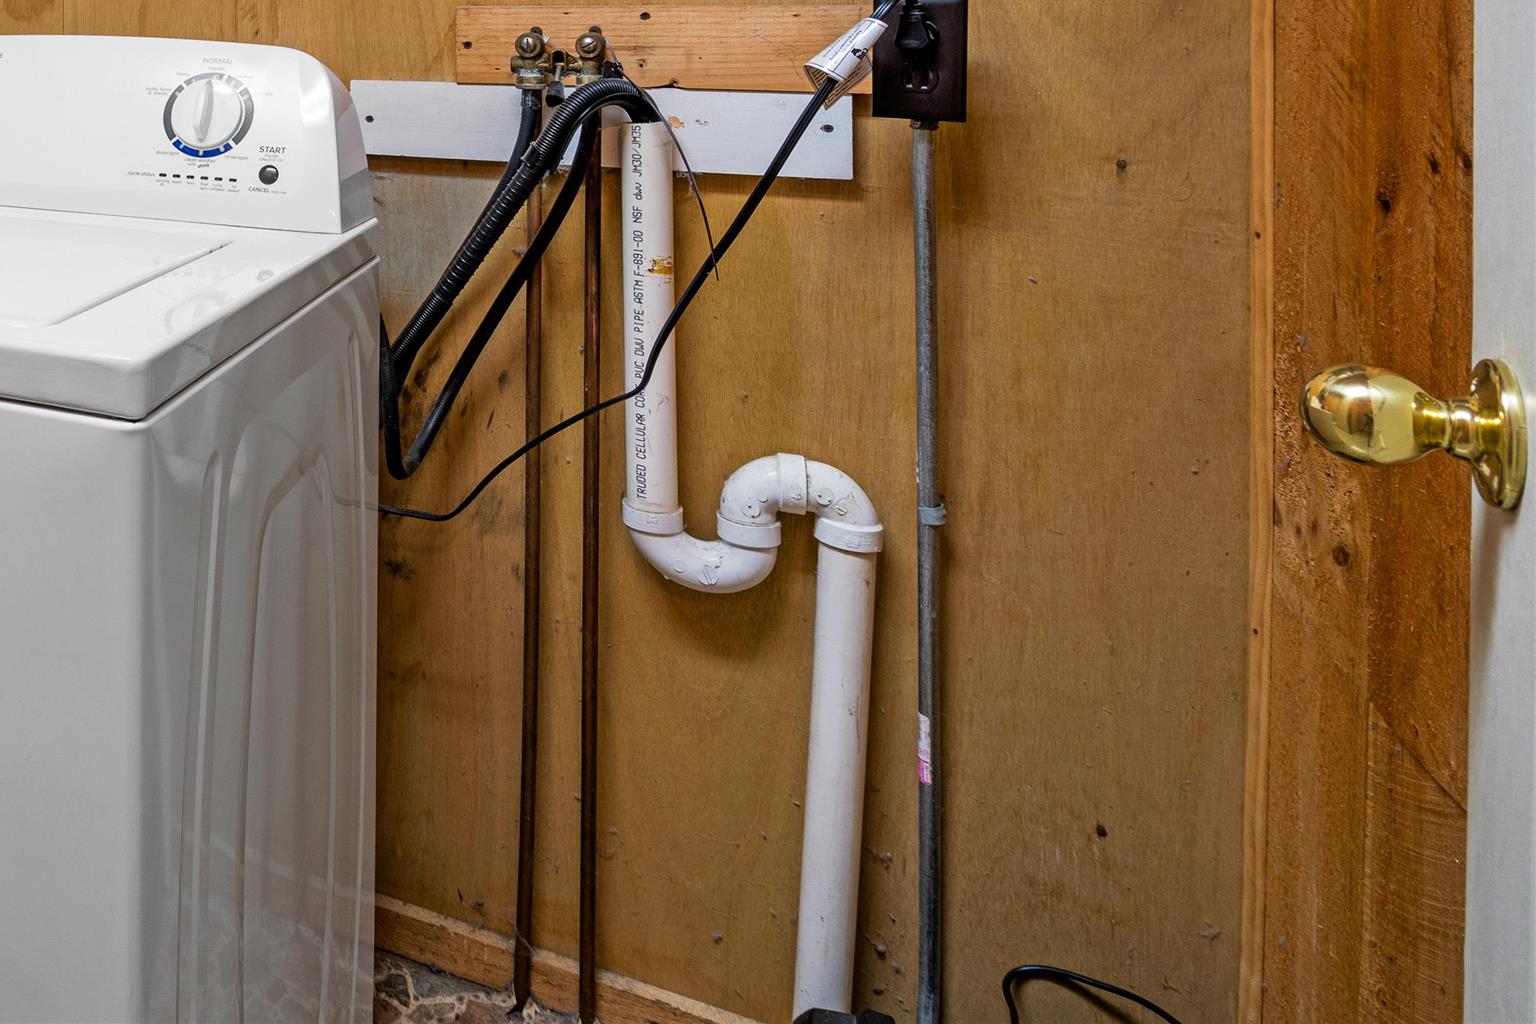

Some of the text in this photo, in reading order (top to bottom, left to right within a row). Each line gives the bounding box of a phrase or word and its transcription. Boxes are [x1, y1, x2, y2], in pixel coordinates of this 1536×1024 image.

[259, 145, 287, 154] START
[631, 125, 642, 177] JM30/JM35
[632, 205, 643, 224] NSF
[632, 229, 644, 277] F-891-00
[633, 279, 644, 305] ASTM
[633, 308, 644, 333] PIPE
[634, 337, 644, 357] DWV
[634, 360, 644, 379] PVC
[635, 384, 646, 408] COR
[635, 413, 647, 460] CELLULAR
[635, 464, 647, 499] TRUDED
